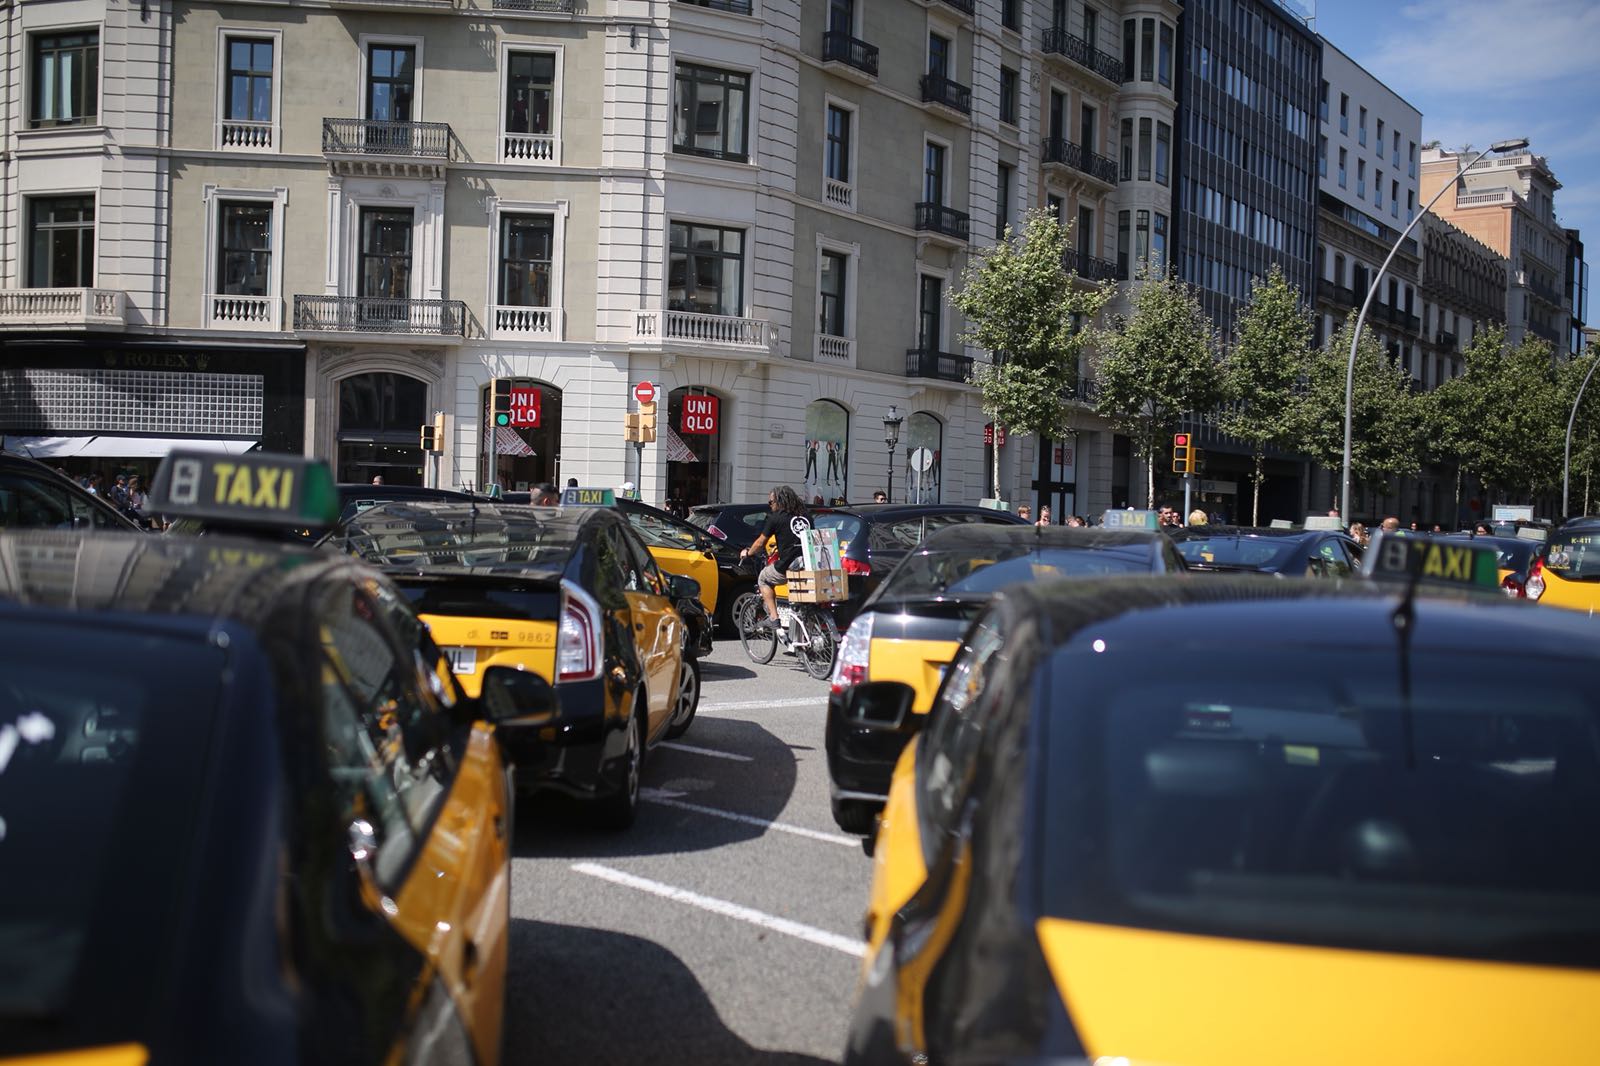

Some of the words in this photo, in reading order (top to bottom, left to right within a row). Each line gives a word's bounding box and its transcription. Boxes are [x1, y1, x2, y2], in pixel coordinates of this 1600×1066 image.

[125, 352, 189, 368] ROLEX
[687, 400, 712, 414] UNI
[687, 416, 713, 431] QLO
[213, 463, 294, 510] TAXI
[579, 490, 602, 504] TAXI
[1121, 512, 1146, 527] TAXI
[518, 631, 552, 643] 9862
